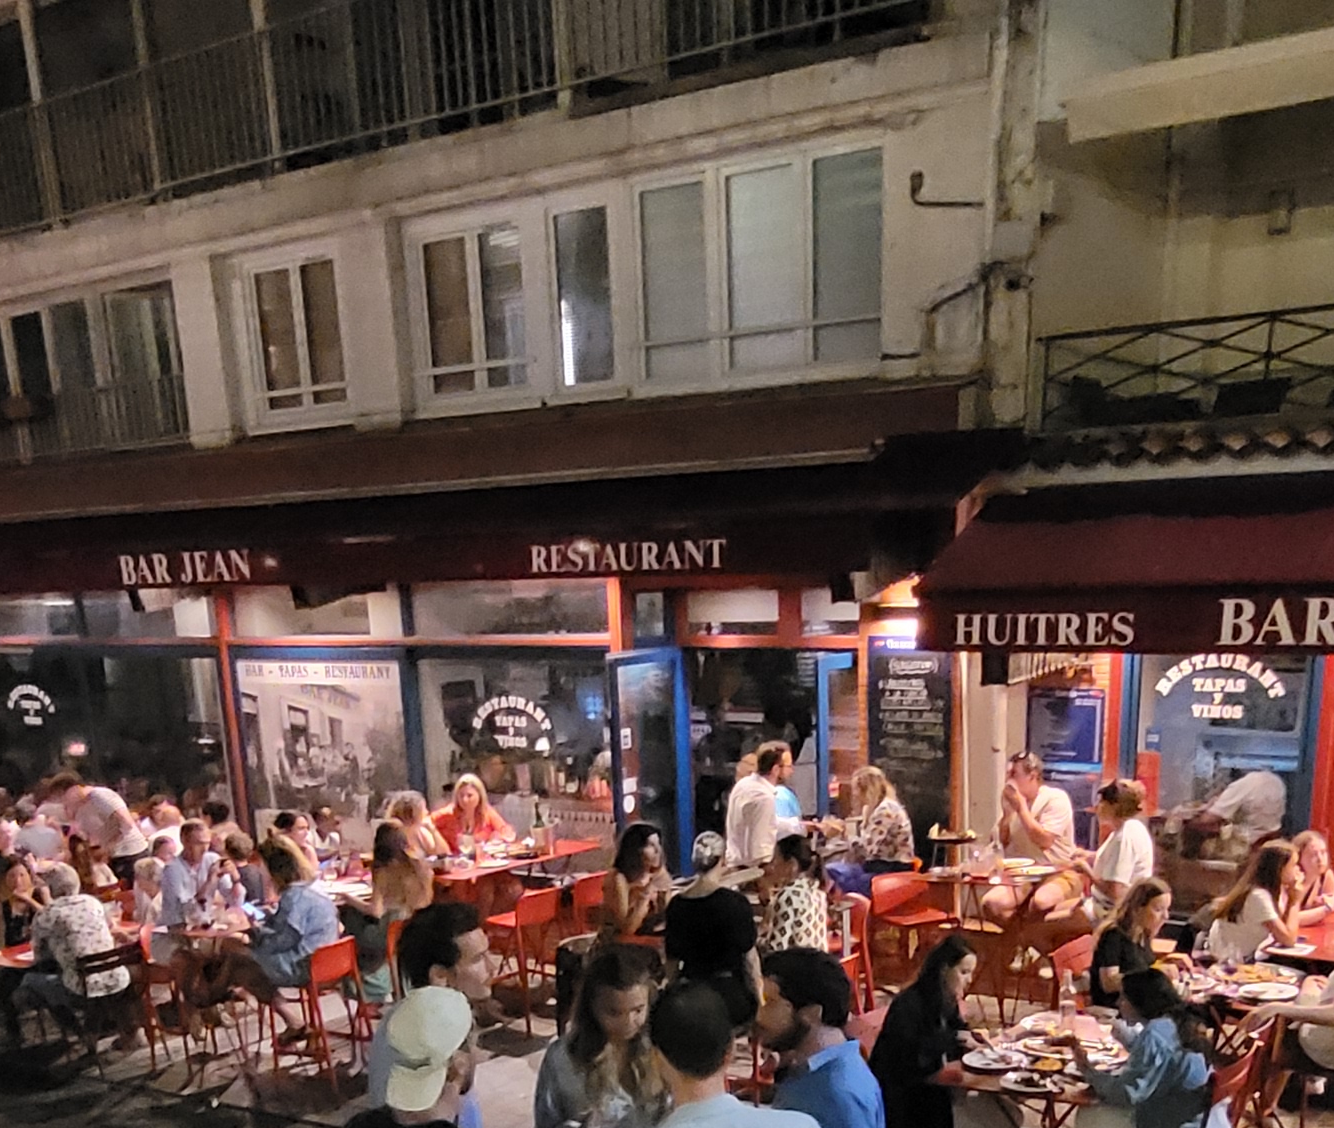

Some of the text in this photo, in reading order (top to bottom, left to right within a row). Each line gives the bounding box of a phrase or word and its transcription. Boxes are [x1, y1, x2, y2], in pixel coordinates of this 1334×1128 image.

[120, 549, 251, 585] BAR JEAN
[531, 539, 727, 573] RESTAURANT
[955, 612, 1135, 646] HUITRES
[1154, 653, 1286, 699] RESTAURANT
[1192, 678, 1247, 693] TAPAS
[1191, 704, 1245, 719] VINOS
